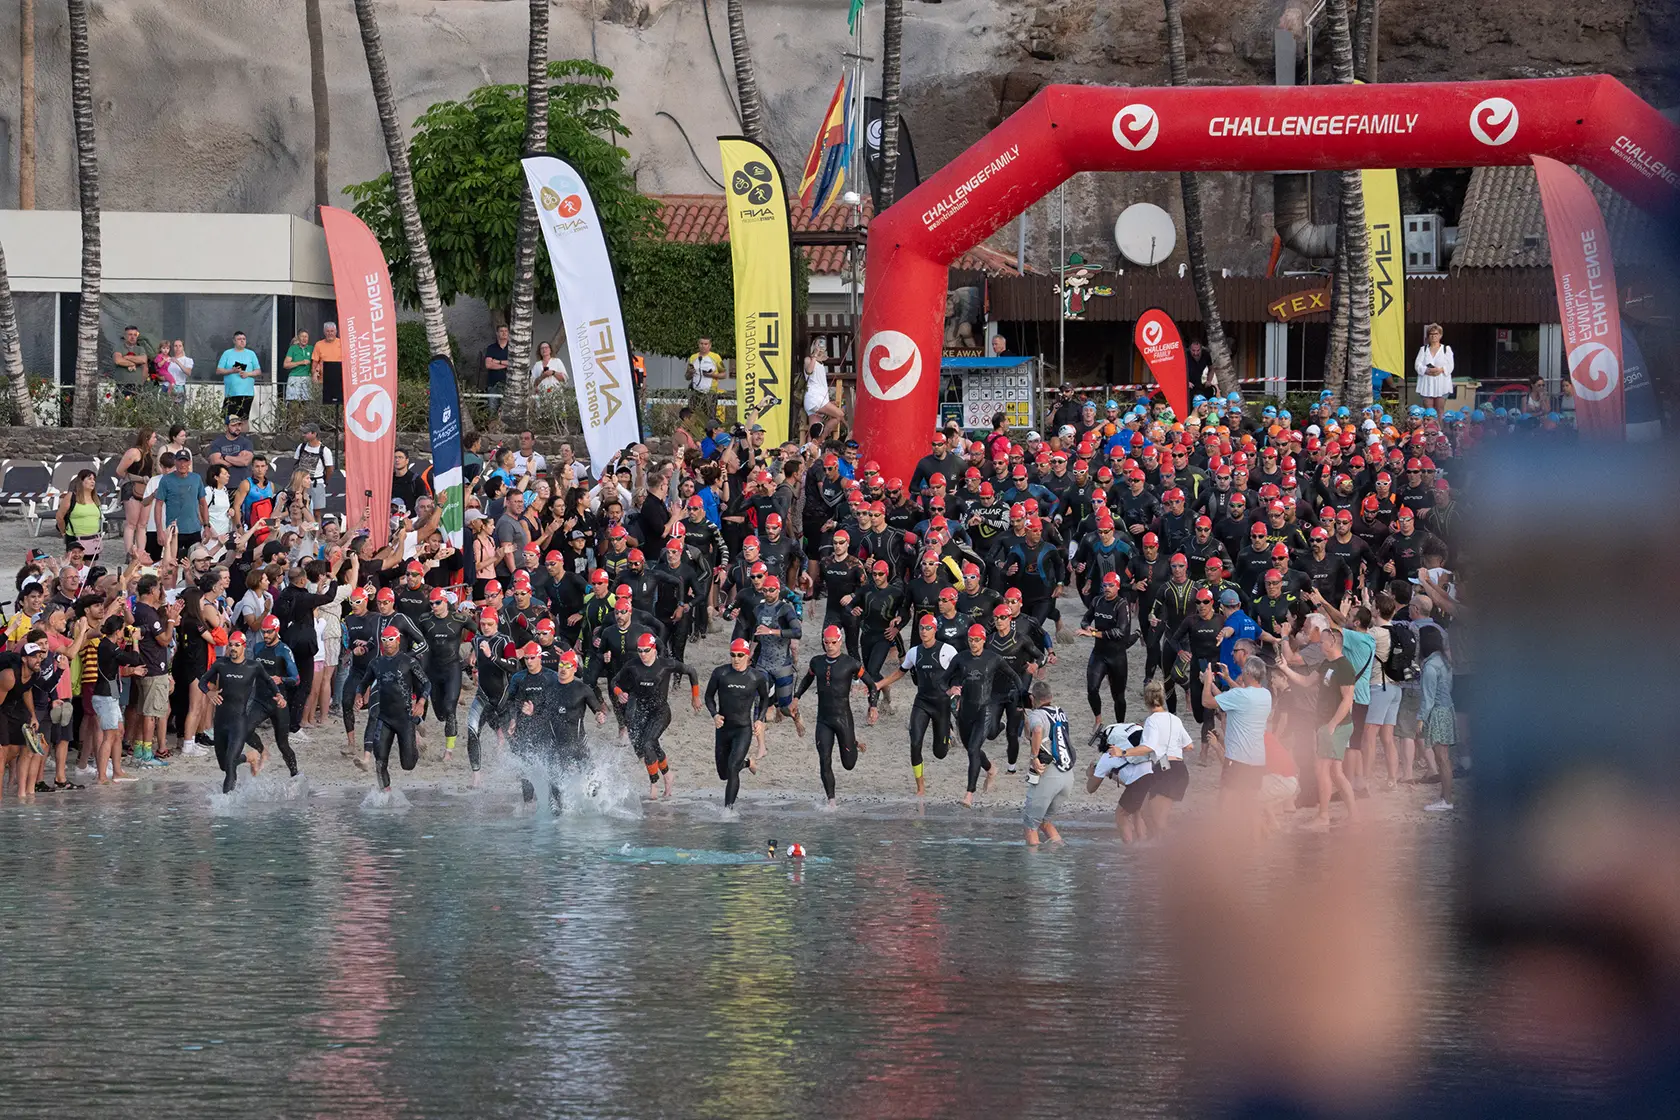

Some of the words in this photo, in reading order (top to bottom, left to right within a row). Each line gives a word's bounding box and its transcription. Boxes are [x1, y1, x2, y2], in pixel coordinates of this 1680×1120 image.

[1208, 113, 1419, 137] CHALLENGEFAMILY
[921, 143, 1020, 225] CHALLENGEFAMILY
[1272, 293, 1325, 318] TEX
